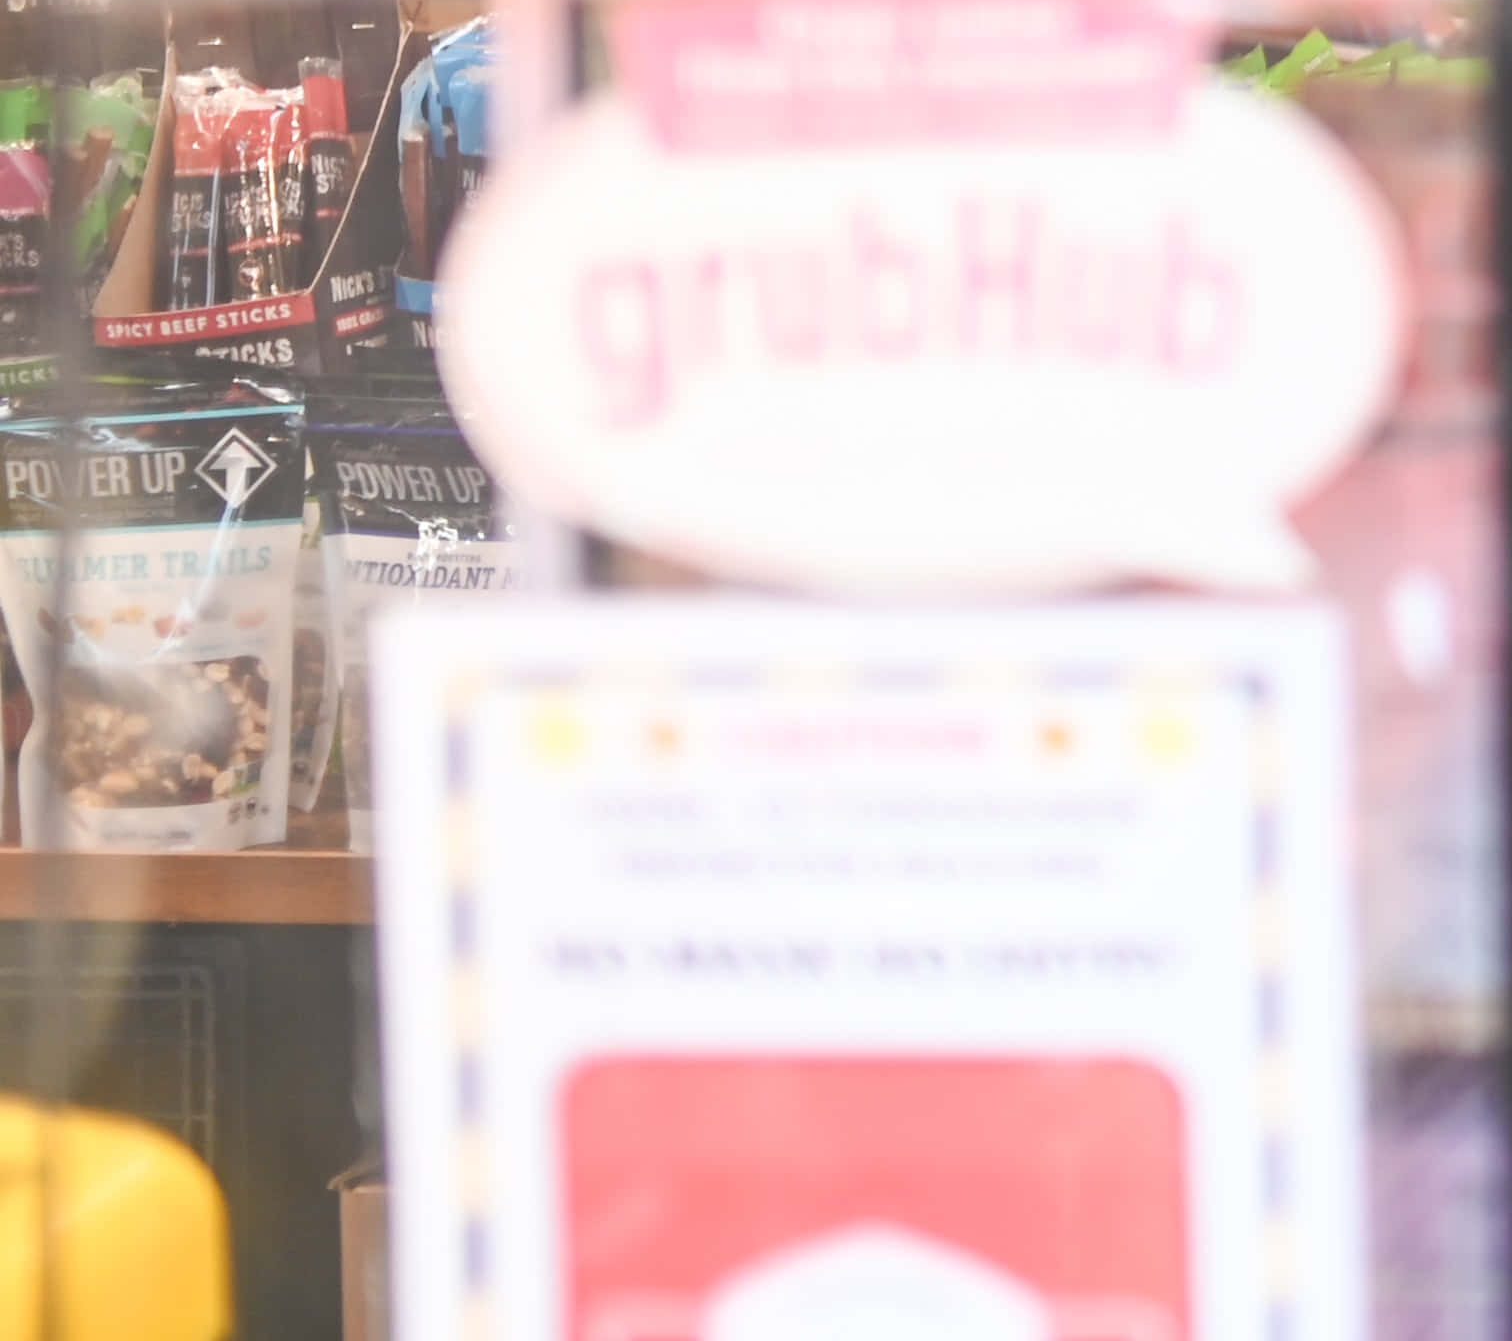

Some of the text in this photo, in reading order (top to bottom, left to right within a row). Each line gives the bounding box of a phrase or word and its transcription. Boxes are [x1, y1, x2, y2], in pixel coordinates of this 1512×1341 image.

[105, 302, 293, 343] SPICY BEEF STICKS
[574, 196, 1244, 427] grubHub
[7, 450, 187, 501] POWER UP
[337, 460, 490, 506] POWER UP
[161, 545, 272, 579] TRAILS
[344, 558, 497, 592] NTIOXIDANT
